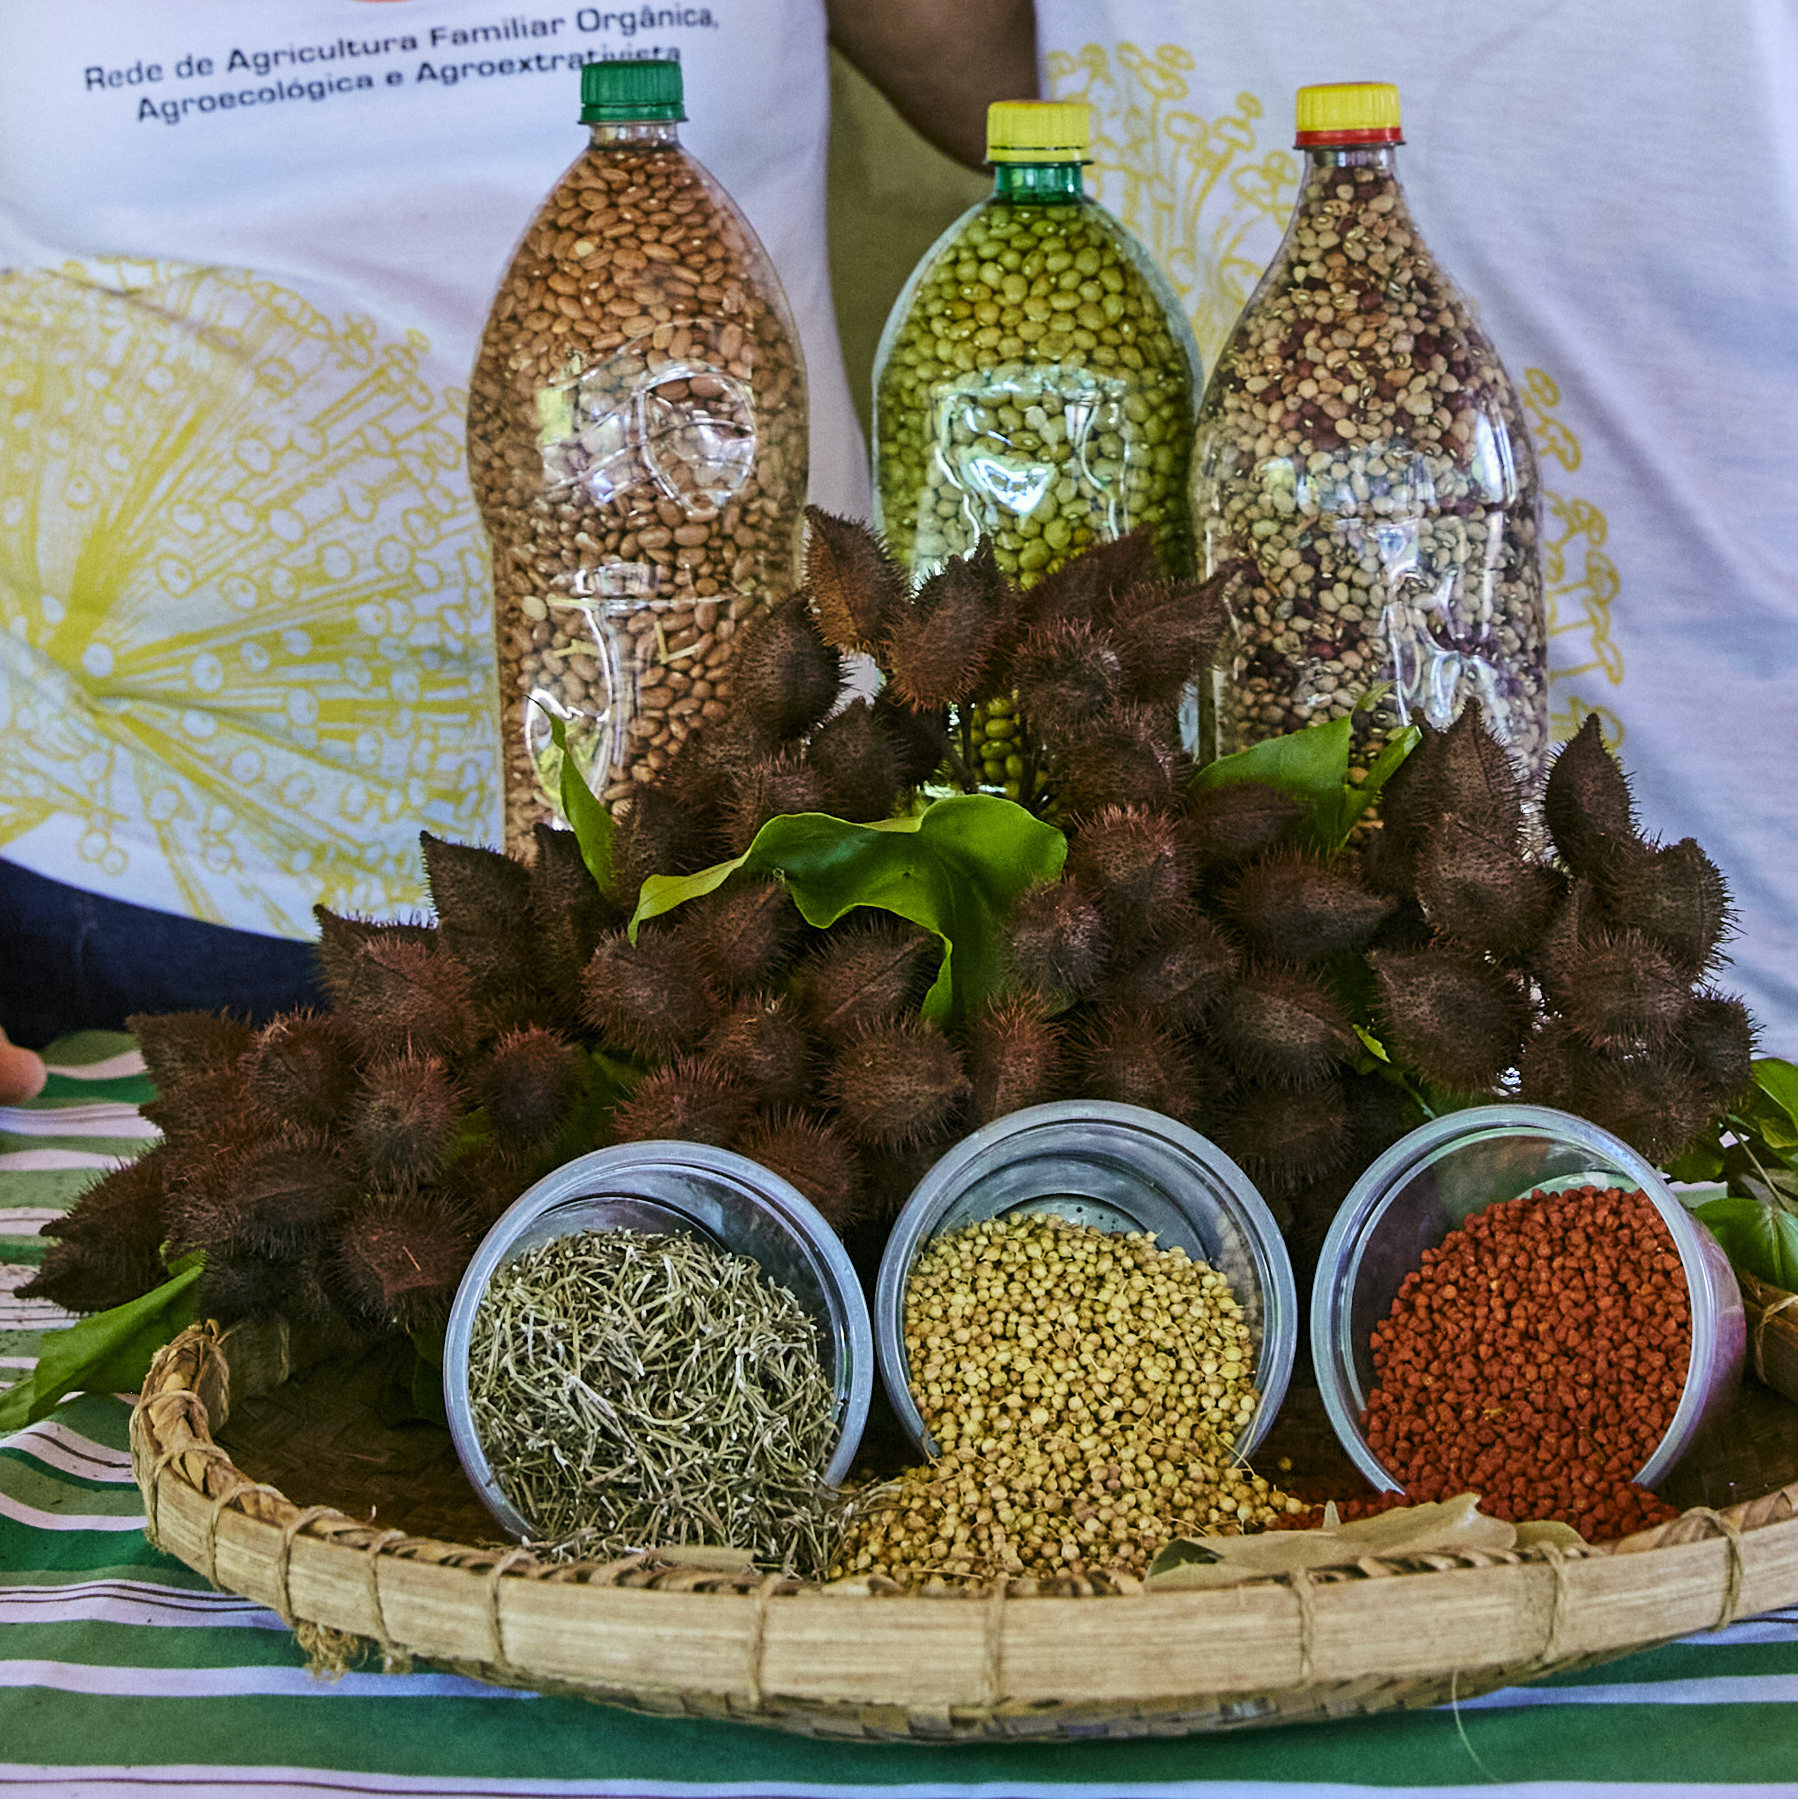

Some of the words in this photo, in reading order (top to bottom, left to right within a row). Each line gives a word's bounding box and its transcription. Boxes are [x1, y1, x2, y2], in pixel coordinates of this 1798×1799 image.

[85, 61, 163, 91] Rede
[176, 54, 214, 79] de
[227, 34, 418, 75] Agricultura
[430, 15, 566, 51] Familiar
[576, 3, 719, 36] Orgânica,
[137, 72, 374, 125] Agroecológica
[386, 70, 402, 86] e
